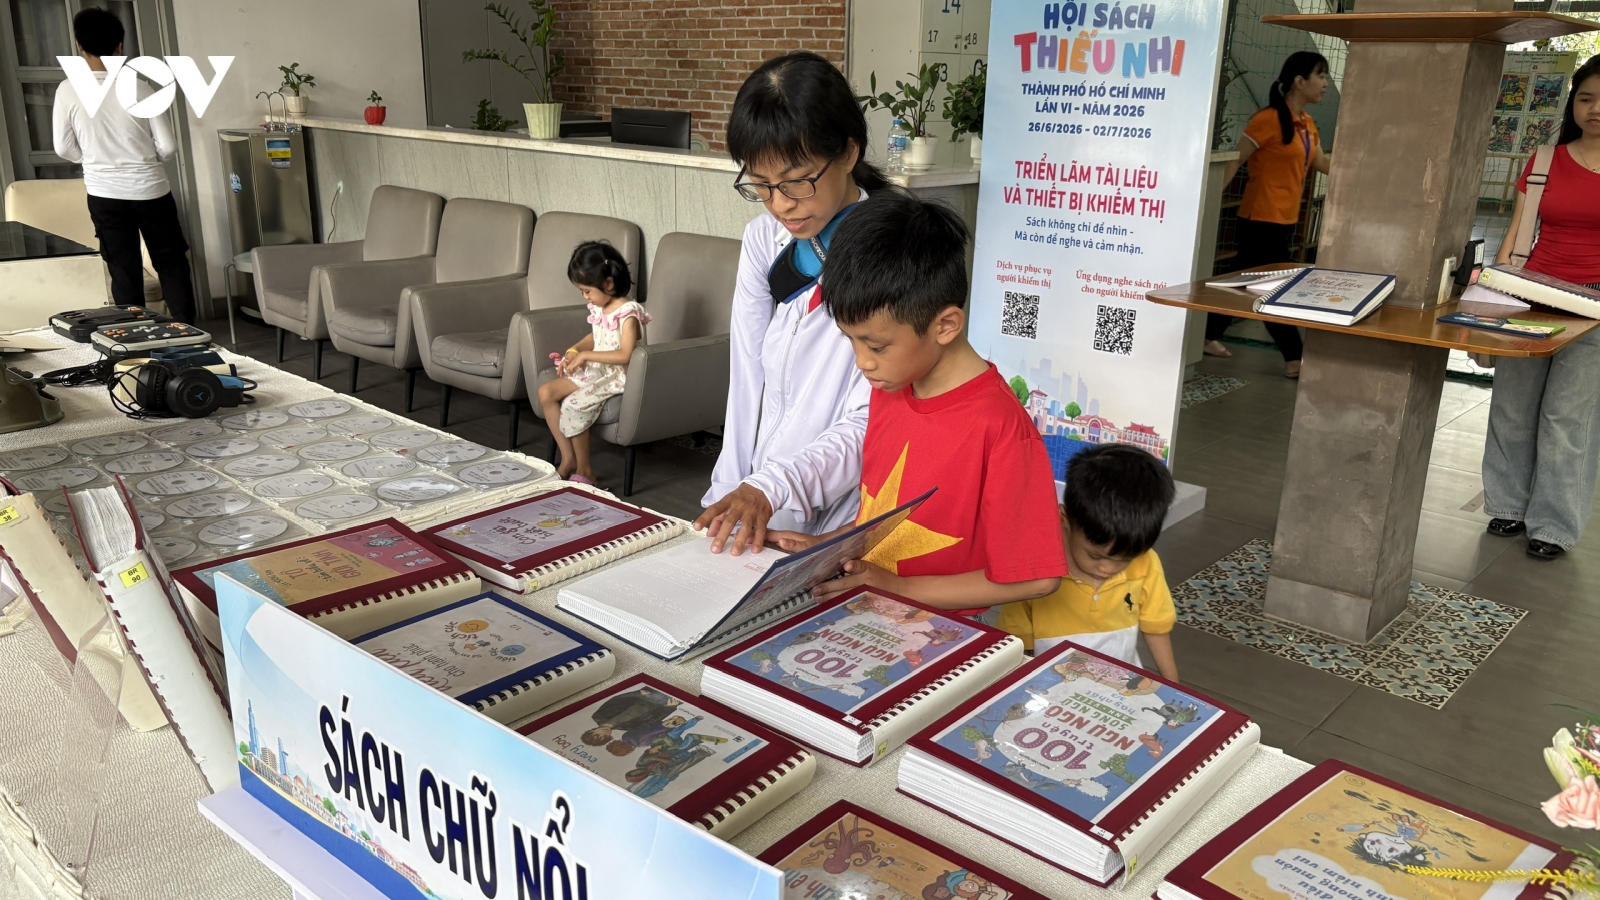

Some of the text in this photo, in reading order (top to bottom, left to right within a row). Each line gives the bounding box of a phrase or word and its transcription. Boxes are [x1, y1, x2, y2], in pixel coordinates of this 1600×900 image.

[1044, 0, 1156, 32] HỘI SÁCH
[928, 30, 939, 43] 17
[967, 33, 978, 46] 18
[1014, 29, 1186, 78] THIẾU NHI
[1022, 80, 1165, 101] THÀNH PHỐ HỒ CHÍ MINH
[1035, 97, 1057, 114] LẦN
[1061, 102, 1072, 114] VI
[1082, 101, 1110, 116] NĂM
[1113, 104, 1145, 117] 2026
[1028, 122, 1082, 135] 26/6/2026
[1093, 126, 1151, 139] 02/7/2026
[1015, 153, 1158, 193] TRIỂN LÃM TÀI LIỆU
[1004, 182, 1166, 223] VÀ THIẾT BỊ KHIẾM THỊ
[1026, 216, 1046, 228] Sách
[1048, 218, 1076, 233] không
[1077, 220, 1091, 232] chỉ
[1093, 219, 1104, 234] để
[1106, 222, 1128, 236] nhìn
[1014, 230, 1144, 256] Mà còn để nghe và cảm nhận.
[996, 260, 1052, 276] Dịch vụ phục vụ
[996, 273, 1051, 290] người khiếm thị
[1076, 268, 1091, 283] Ứng
[1093, 272, 1112, 287] dụng
[1114, 275, 1133, 289] nghe
[1134, 278, 1151, 289] sách
[1081, 284, 1144, 301] cho người khiếm
[128, 568, 138, 576] BR
[132, 574, 141, 583] 90
[820, 629, 899, 663] NGỤ NGÔN
[866, 635, 898, 649] SONG
[402, 642, 466, 678] cho hạnh phúc
[794, 649, 858, 678] 100
[822, 644, 863, 663] truyện
[1086, 690, 1136, 715] hay nhất
[1091, 711, 1129, 730] SONG
[1107, 709, 1129, 721] ANH
[1040, 703, 1135, 751] NGỤ NGÔ
[1042, 721, 1094, 750] truyện
[552, 734, 571, 750] boy
[1013, 727, 1091, 769] 100
[569, 745, 598, 763] every
[319, 695, 410, 842] SÁCH
[419, 767, 497, 899] CHỮ
[1292, 855, 1319, 869] vui
